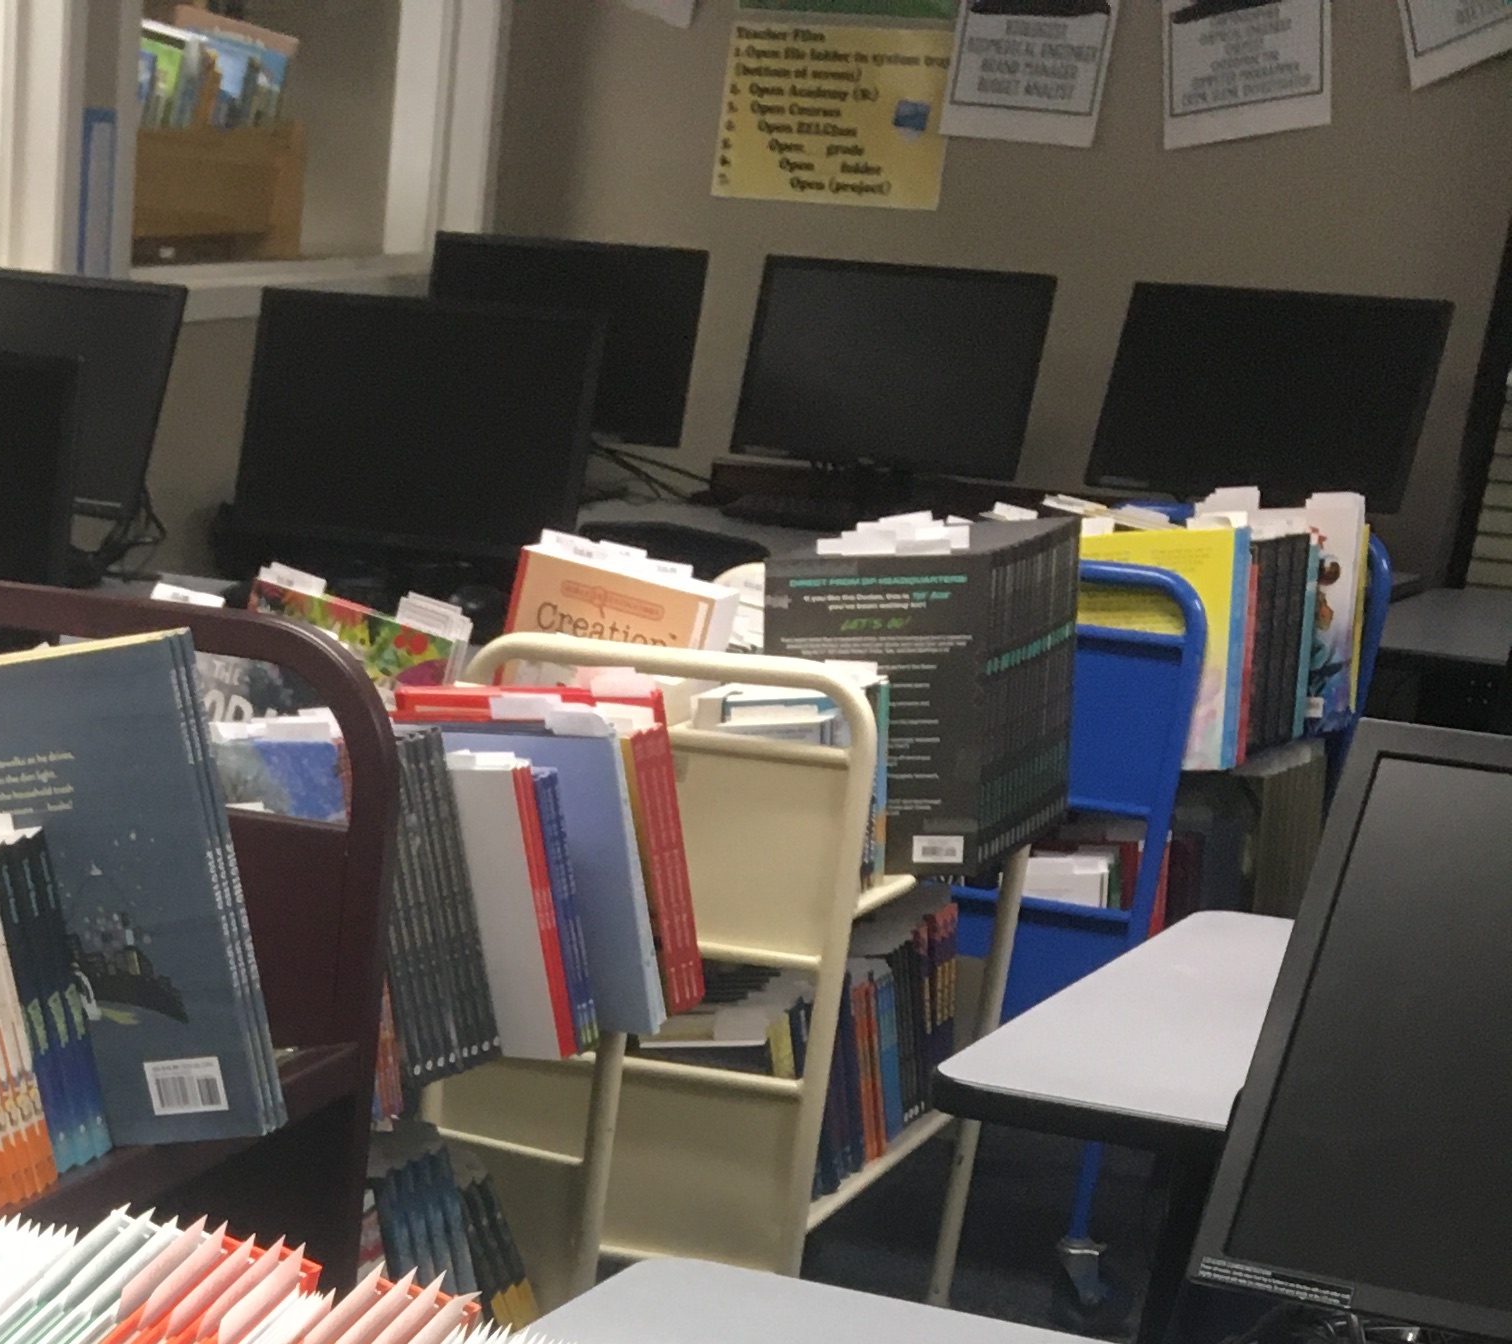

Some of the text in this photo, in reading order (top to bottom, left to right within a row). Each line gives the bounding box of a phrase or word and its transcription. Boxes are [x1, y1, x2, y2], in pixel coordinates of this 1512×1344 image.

[793, 29, 825, 42] Files
[746, 45, 781, 59] Open
[749, 82, 784, 97] Open
